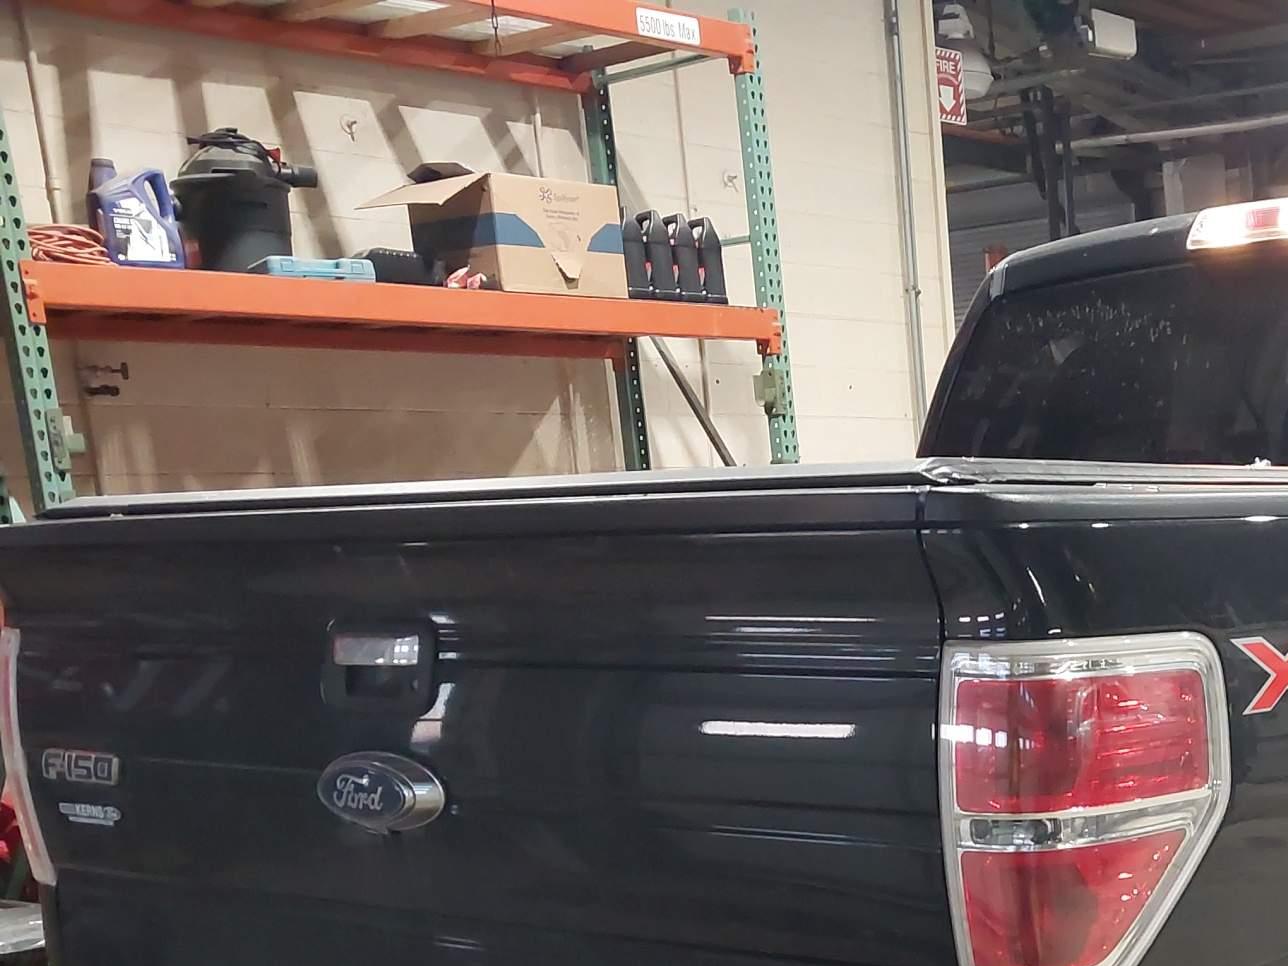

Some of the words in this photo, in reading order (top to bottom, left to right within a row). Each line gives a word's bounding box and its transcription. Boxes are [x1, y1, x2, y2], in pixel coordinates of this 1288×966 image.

[639, 14, 662, 35] 5500
[662, 18, 676, 38] lbs
[677, 21, 698, 41] Max
[333, 774, 384, 810] Ford
